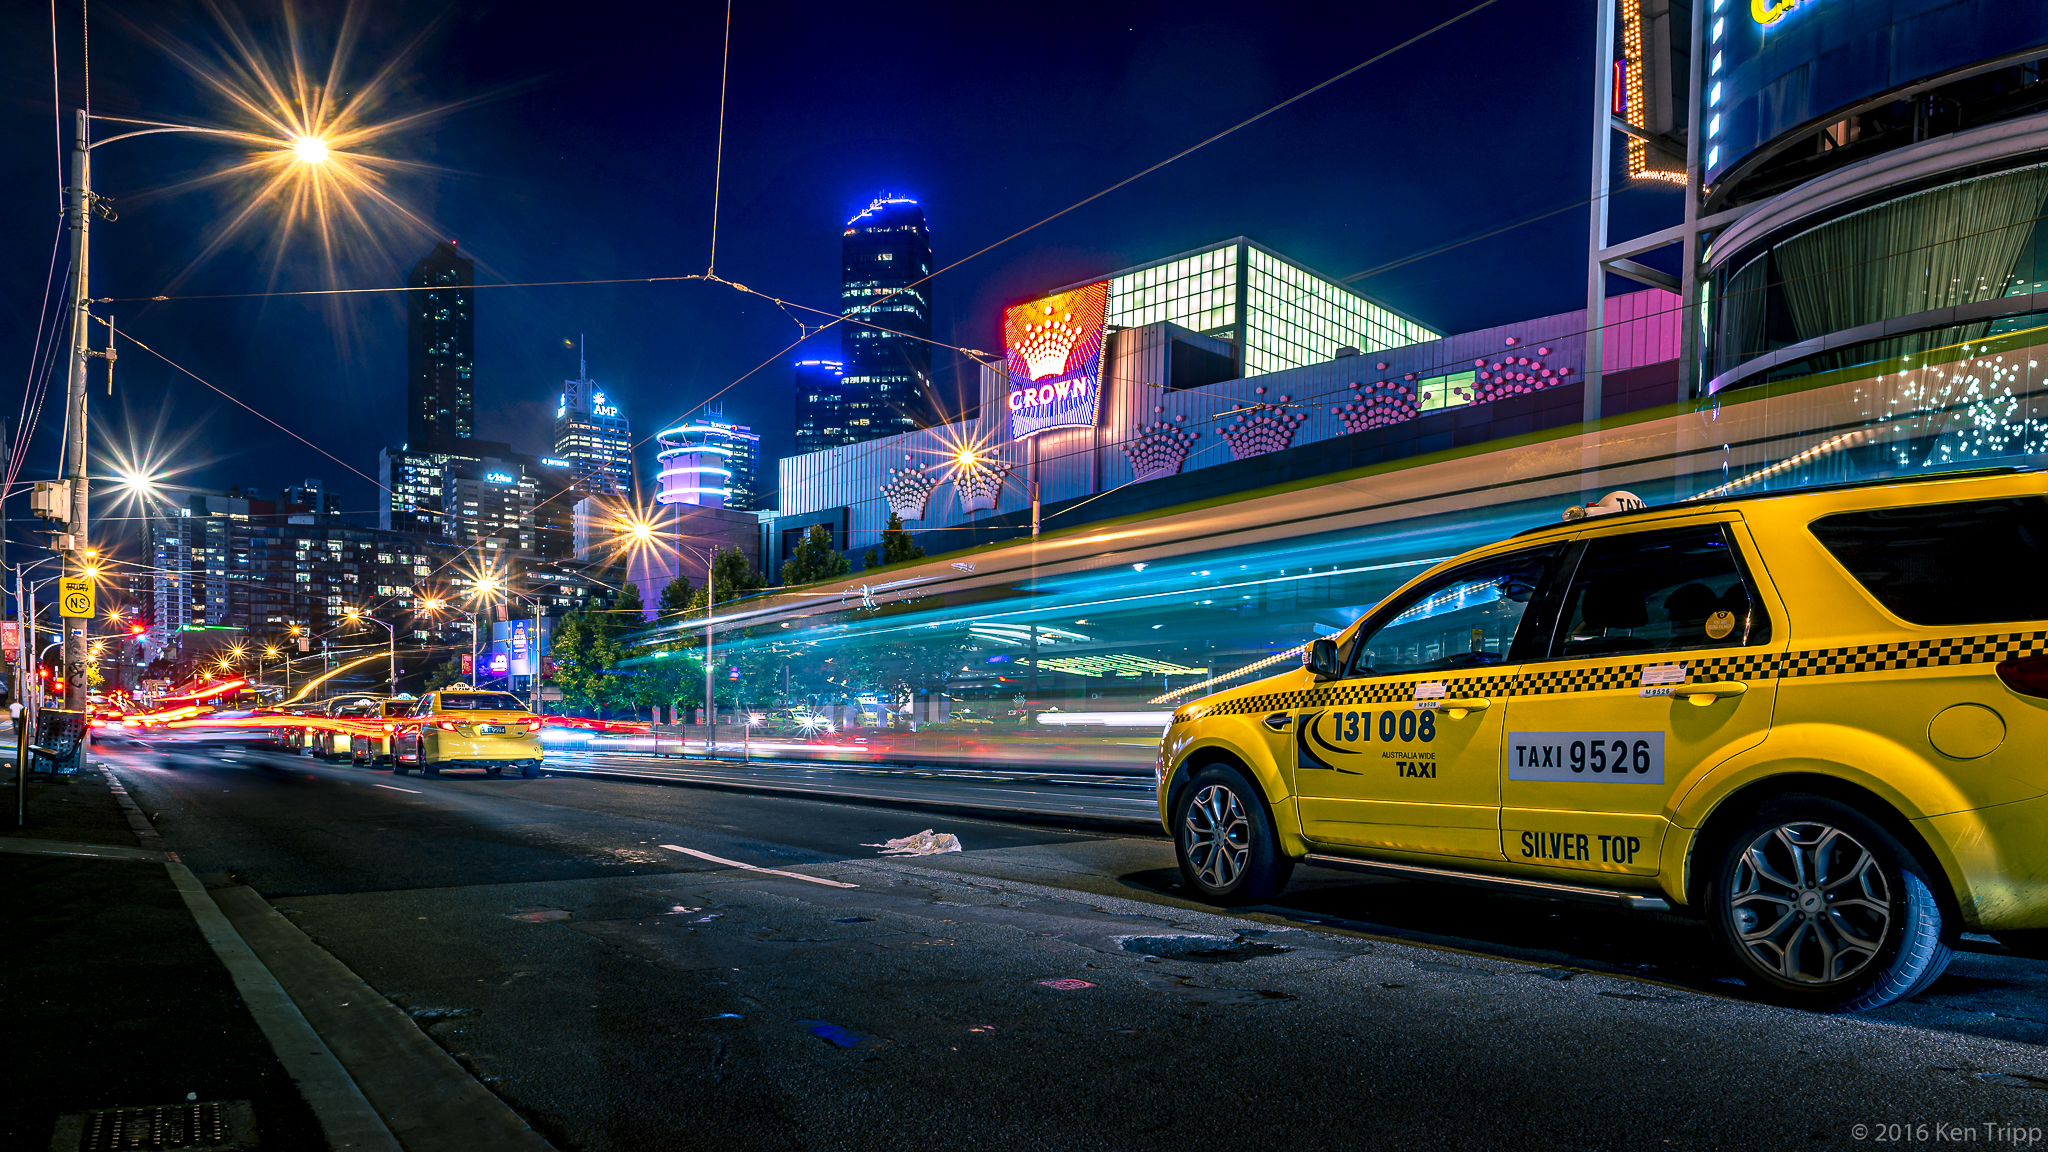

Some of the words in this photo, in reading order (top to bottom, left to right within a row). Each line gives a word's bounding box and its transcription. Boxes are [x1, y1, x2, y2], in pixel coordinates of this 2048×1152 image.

[1008, 376, 1088, 411] CROWN
[593, 405, 618, 417] AMP
[70, 597, 86, 609] NS
[1333, 711, 1371, 742] 131
[1379, 710, 1436, 743] 008
[1381, 752, 1417, 760] AUSTRALIA
[1418, 752, 1436, 760] WIDE
[1515, 744, 1562, 768] TAXI
[1569, 739, 1651, 775] 9526
[1396, 761, 1436, 778] TAXI
[1521, 831, 1590, 862] SILVER
[1598, 835, 1641, 864] TOP
